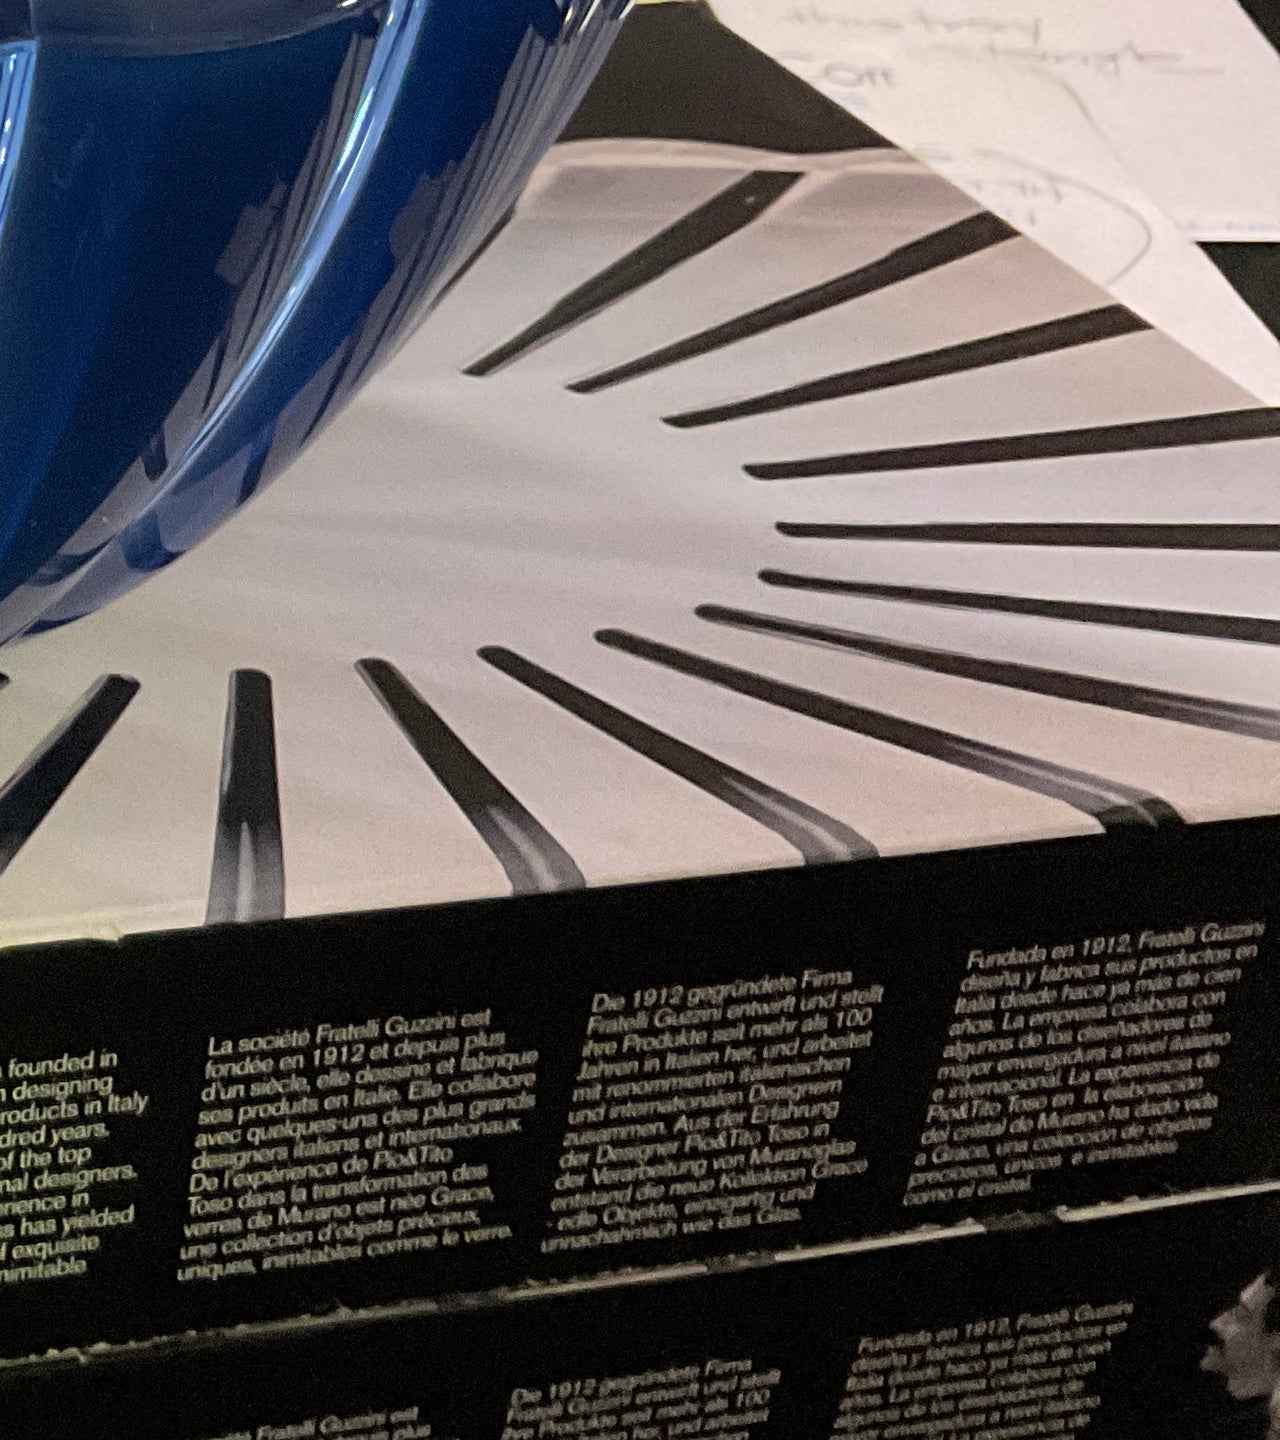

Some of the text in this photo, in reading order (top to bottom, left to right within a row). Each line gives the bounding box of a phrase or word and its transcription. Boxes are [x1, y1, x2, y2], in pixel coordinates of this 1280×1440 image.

[8, 1051, 94, 1077] founded
[99, 1052, 117, 1067] in
[12, 1076, 112, 1100] designing
[84, 1099, 101, 1115] in
[107, 1091, 148, 1114] Italy
[19, 1146, 51, 1168] the
[57, 1146, 91, 1165] top
[71, 1185, 89, 1206] in
[20, 1217, 56, 1235] has
